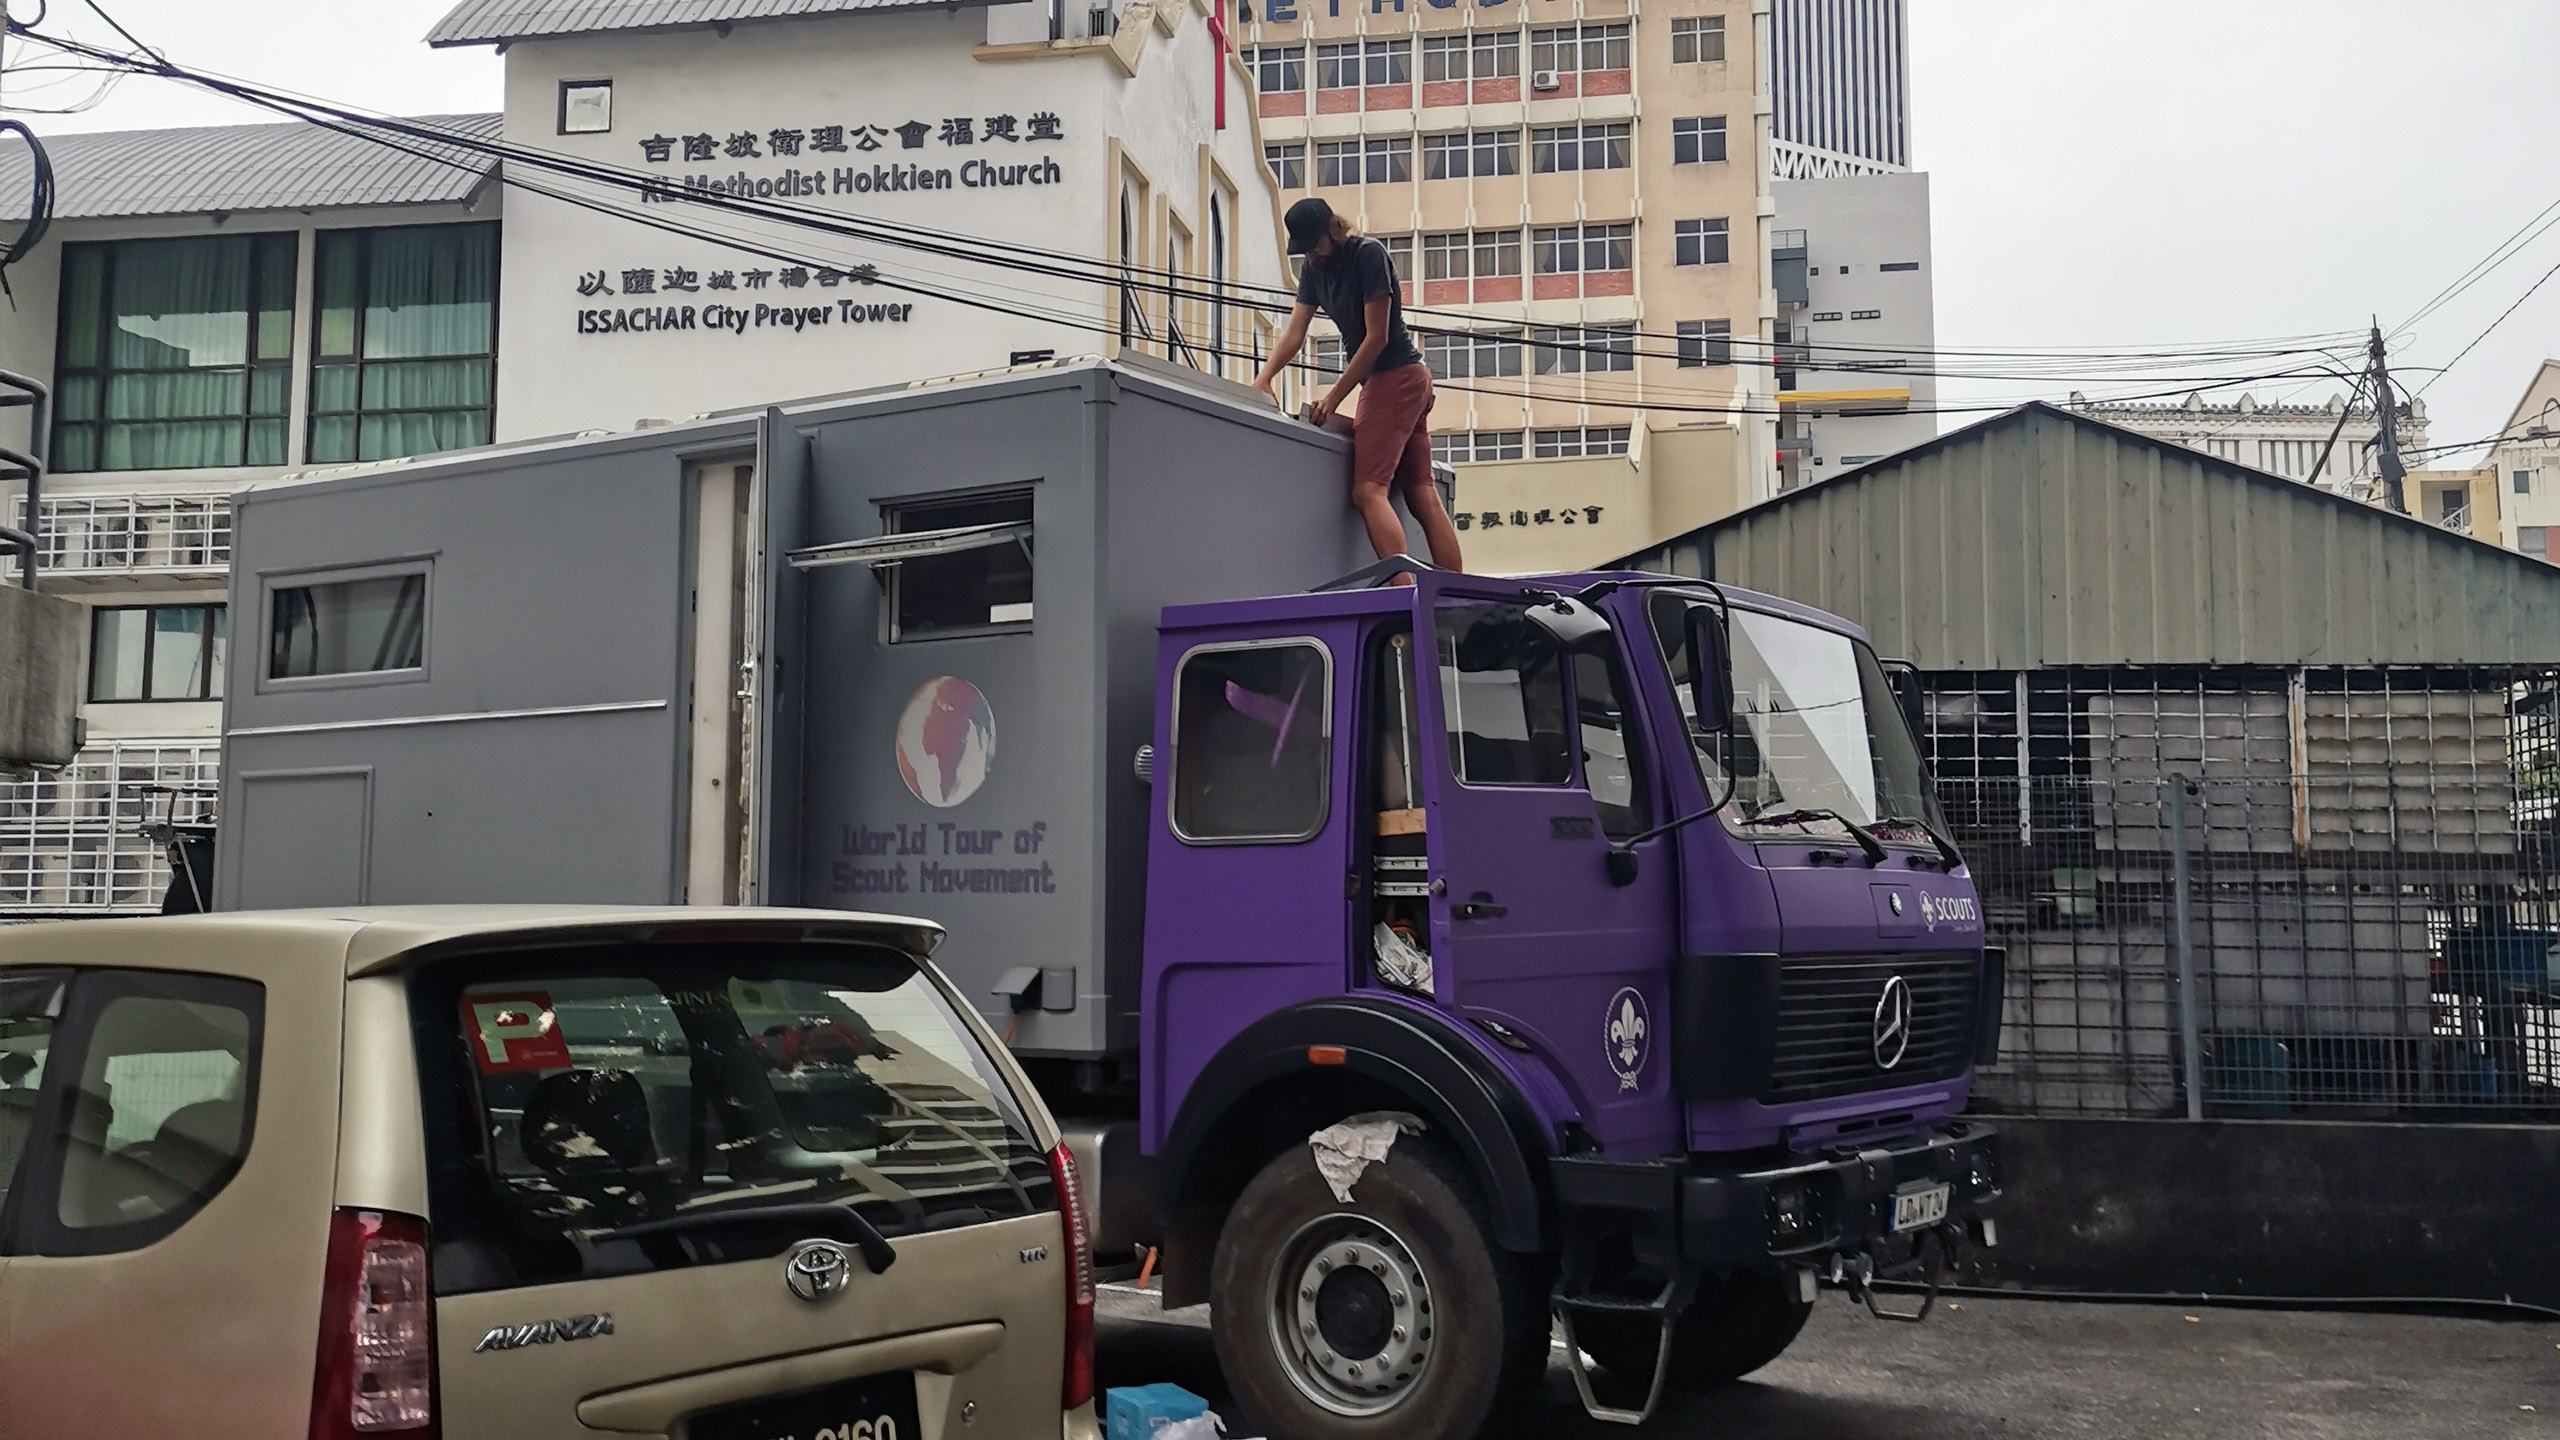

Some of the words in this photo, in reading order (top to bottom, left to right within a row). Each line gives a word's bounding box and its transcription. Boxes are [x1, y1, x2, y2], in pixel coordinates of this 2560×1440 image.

[638, 111, 1065, 163] 吉隆坡衛理公會福建堂
[684, 169, 827, 199] Methodist
[833, 163, 953, 195] Hokkien
[960, 156, 1062, 188] Church
[577, 305, 697, 334] ISSACHAR
[702, 304, 750, 334] City
[754, 303, 833, 333] Prayer
[837, 299, 913, 324] Tower
[843, 822, 928, 857] World
[937, 821, 1004, 856] Tour
[1014, 820, 1047, 855] of
[832, 859, 910, 894] Scout
[919, 859, 1057, 894] Movement
[1935, 896, 1977, 921] SCOUTS
[472, 1000, 555, 1064] P
[473, 1311, 615, 1353] AVANZA
